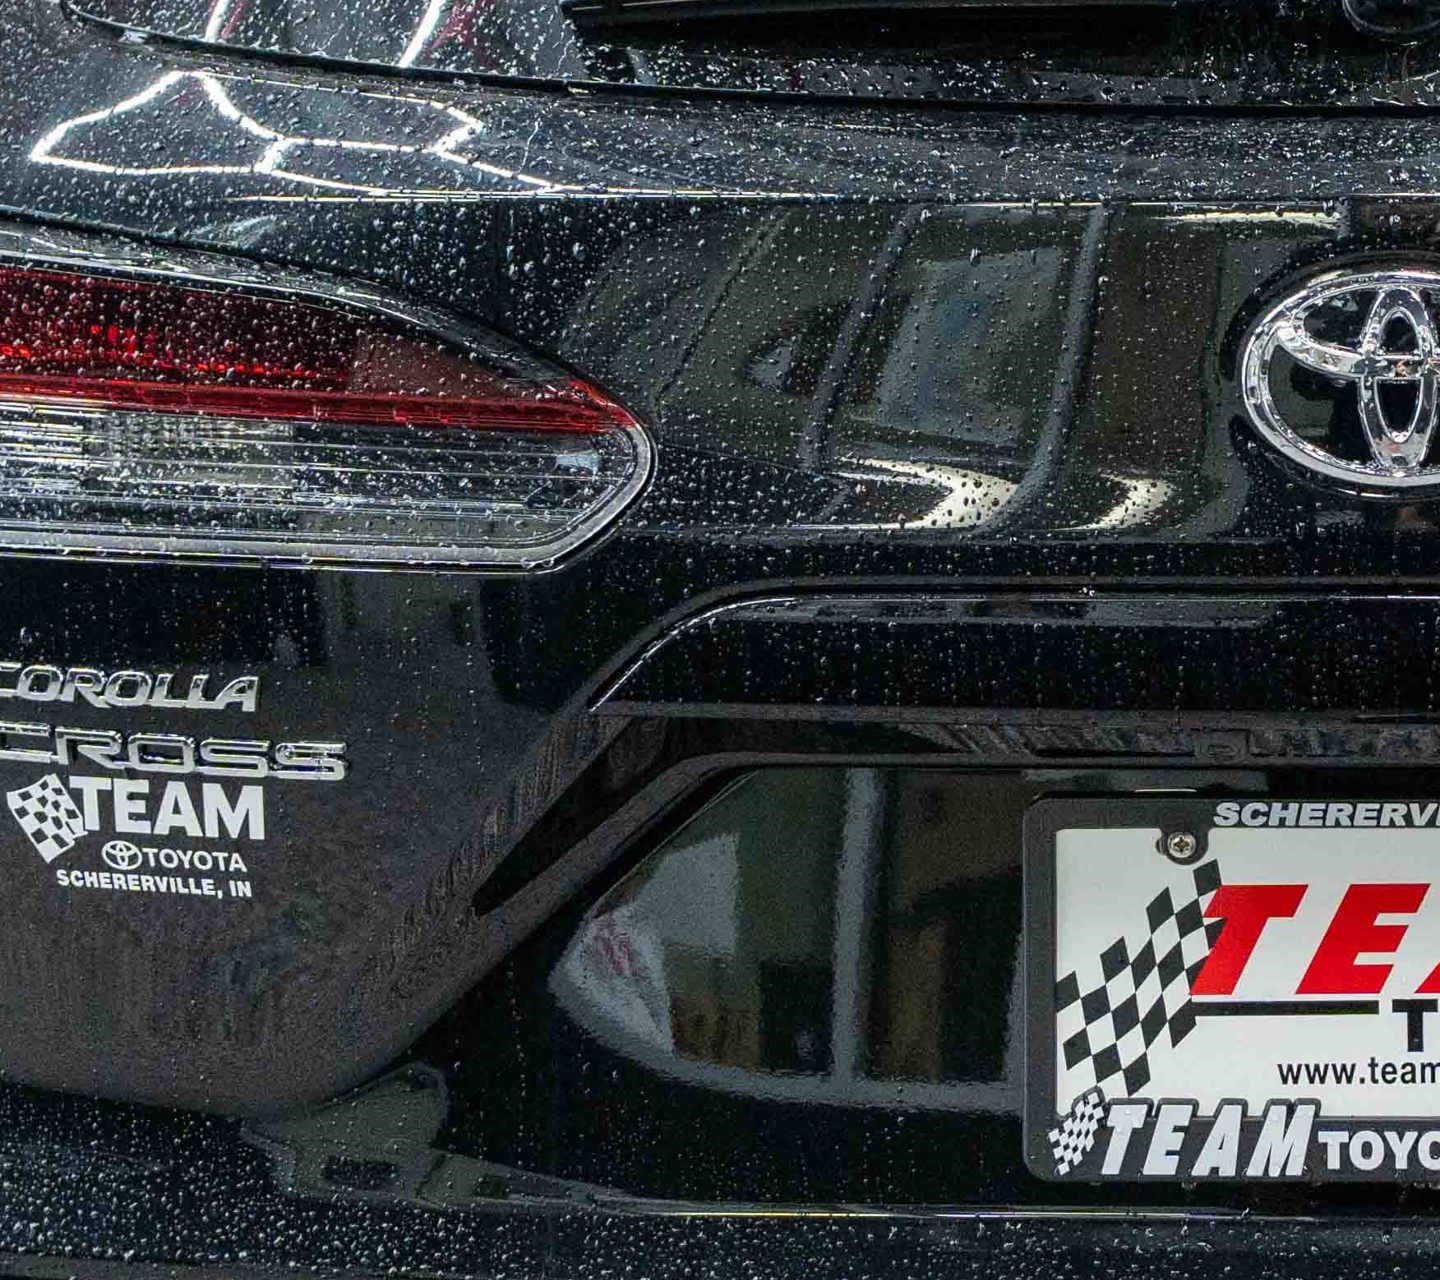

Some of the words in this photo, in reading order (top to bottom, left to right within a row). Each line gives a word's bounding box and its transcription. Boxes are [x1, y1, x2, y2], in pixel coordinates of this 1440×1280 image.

[68, 775, 265, 840] TEAM
[56, 868, 223, 899] SCHERERVILLE,
[228, 879, 252, 898] IN
[143, 847, 248, 873] TOYOTA
[1100, 1102, 1315, 1177] TEAM
